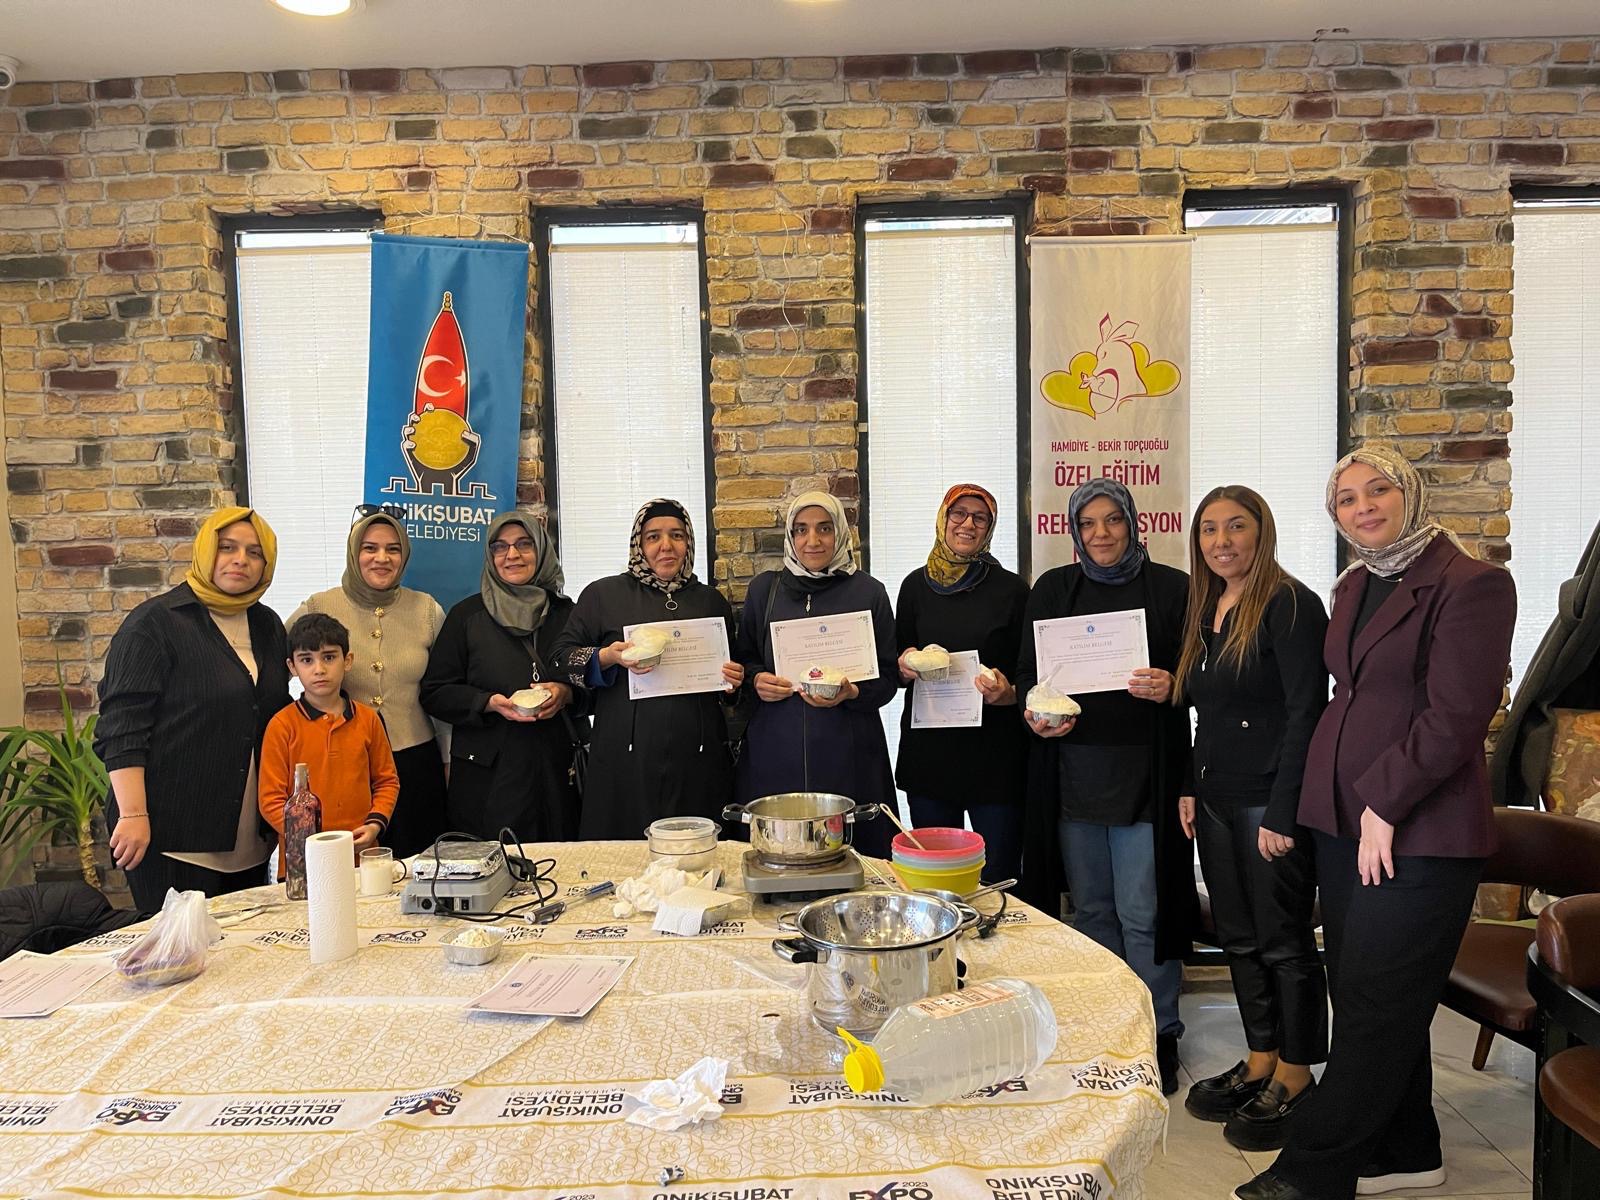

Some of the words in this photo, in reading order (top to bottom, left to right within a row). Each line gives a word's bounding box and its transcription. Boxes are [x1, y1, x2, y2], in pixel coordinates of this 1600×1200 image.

[1051, 439, 1089, 452] HAMİDİYE
[1098, 438, 1121, 451] BEKİR
[1124, 437, 1169, 453] TOPÇUOĞLU
[406, 524, 481, 542] ELEDİYESİ
